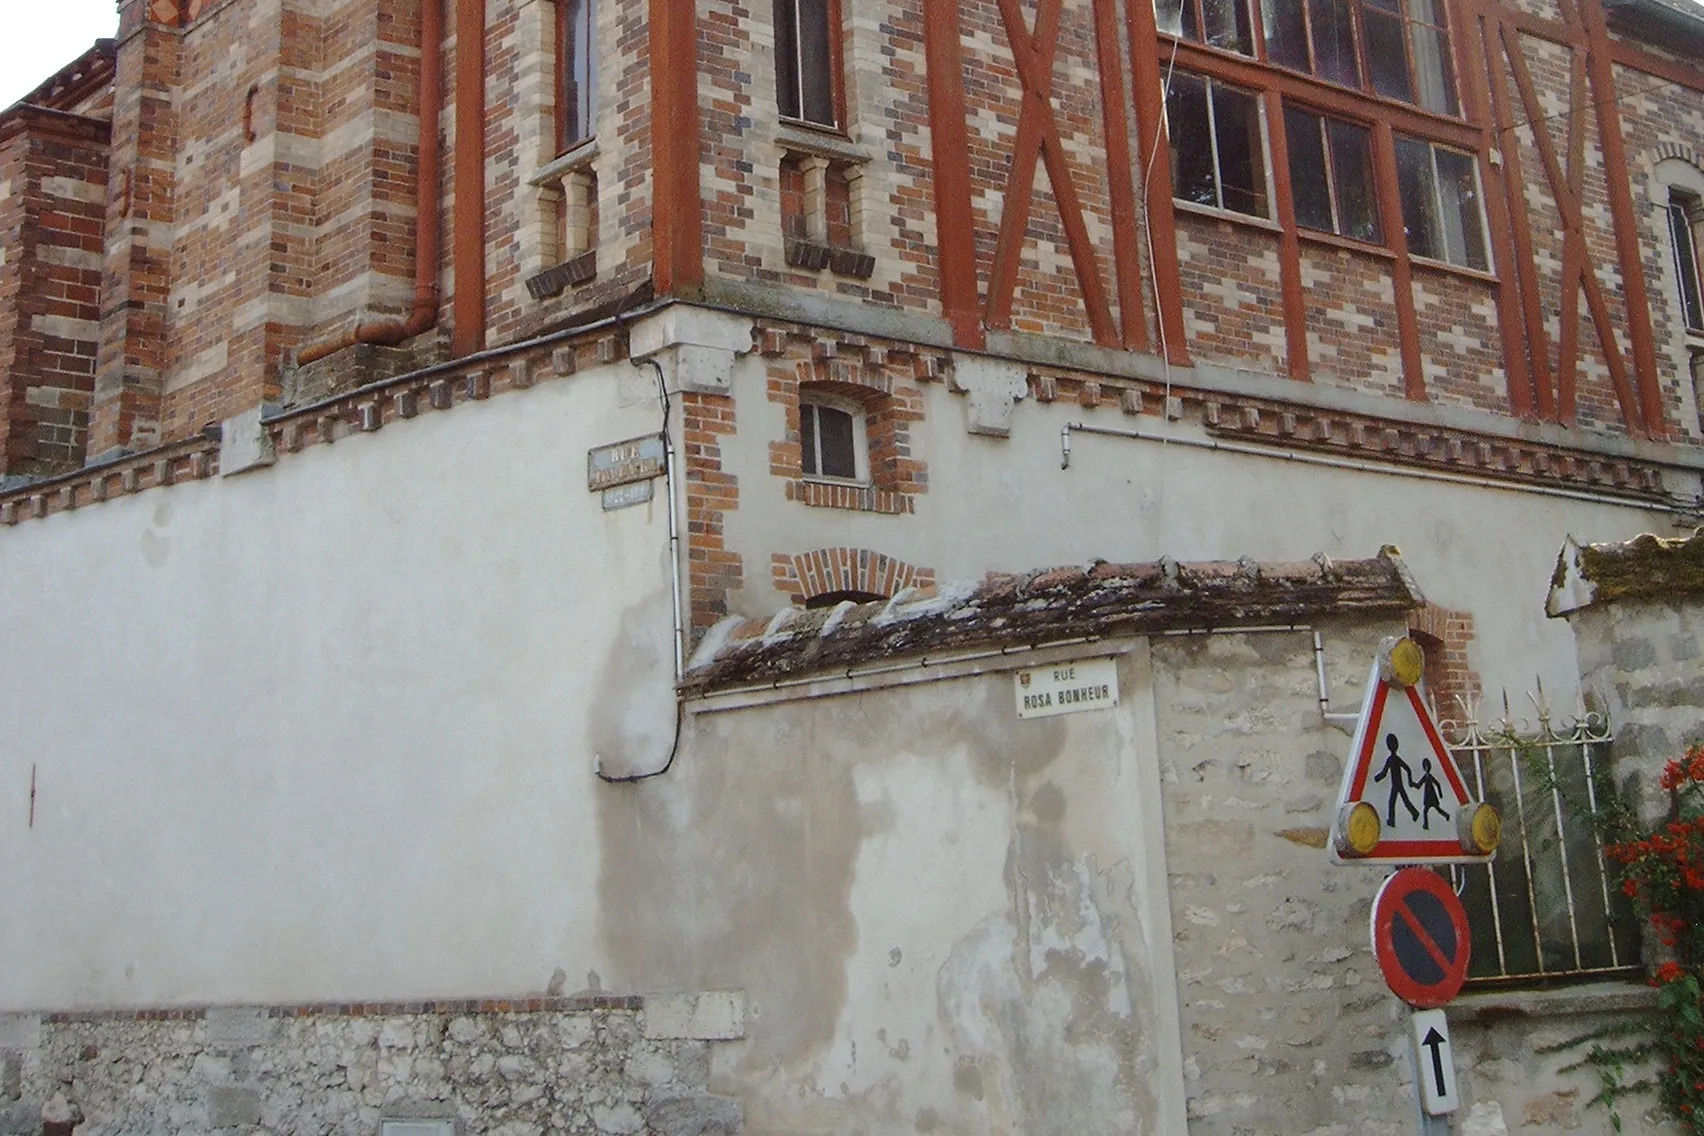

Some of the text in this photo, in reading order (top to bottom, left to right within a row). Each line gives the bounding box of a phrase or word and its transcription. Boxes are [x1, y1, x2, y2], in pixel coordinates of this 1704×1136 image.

[1053, 667, 1076, 681] RUE
[1023, 684, 1109, 710] ROSA BONHEUR
